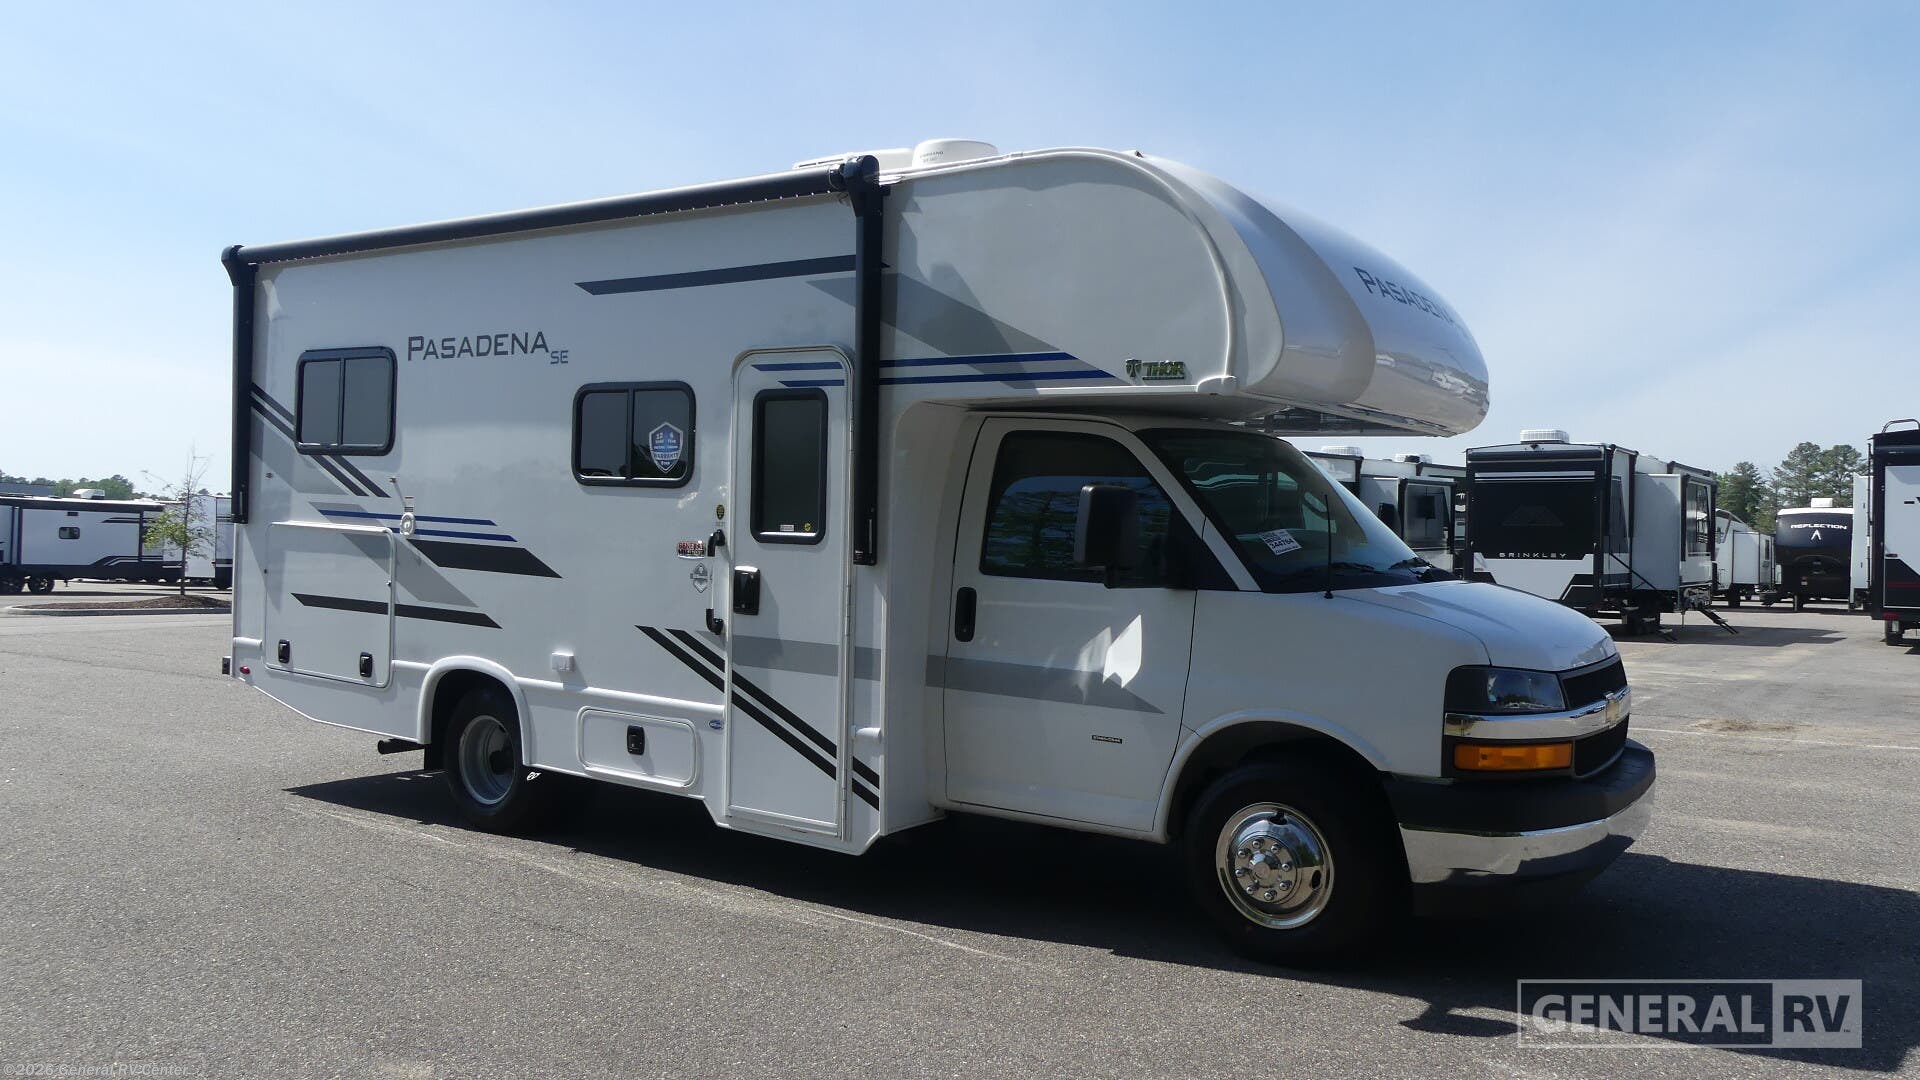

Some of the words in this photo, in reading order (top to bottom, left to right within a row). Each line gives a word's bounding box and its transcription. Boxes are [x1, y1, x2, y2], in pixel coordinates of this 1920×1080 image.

[407, 331, 549, 361] PASADENA
[550, 349, 569, 364] SE
[1142, 361, 1185, 377] THOR
